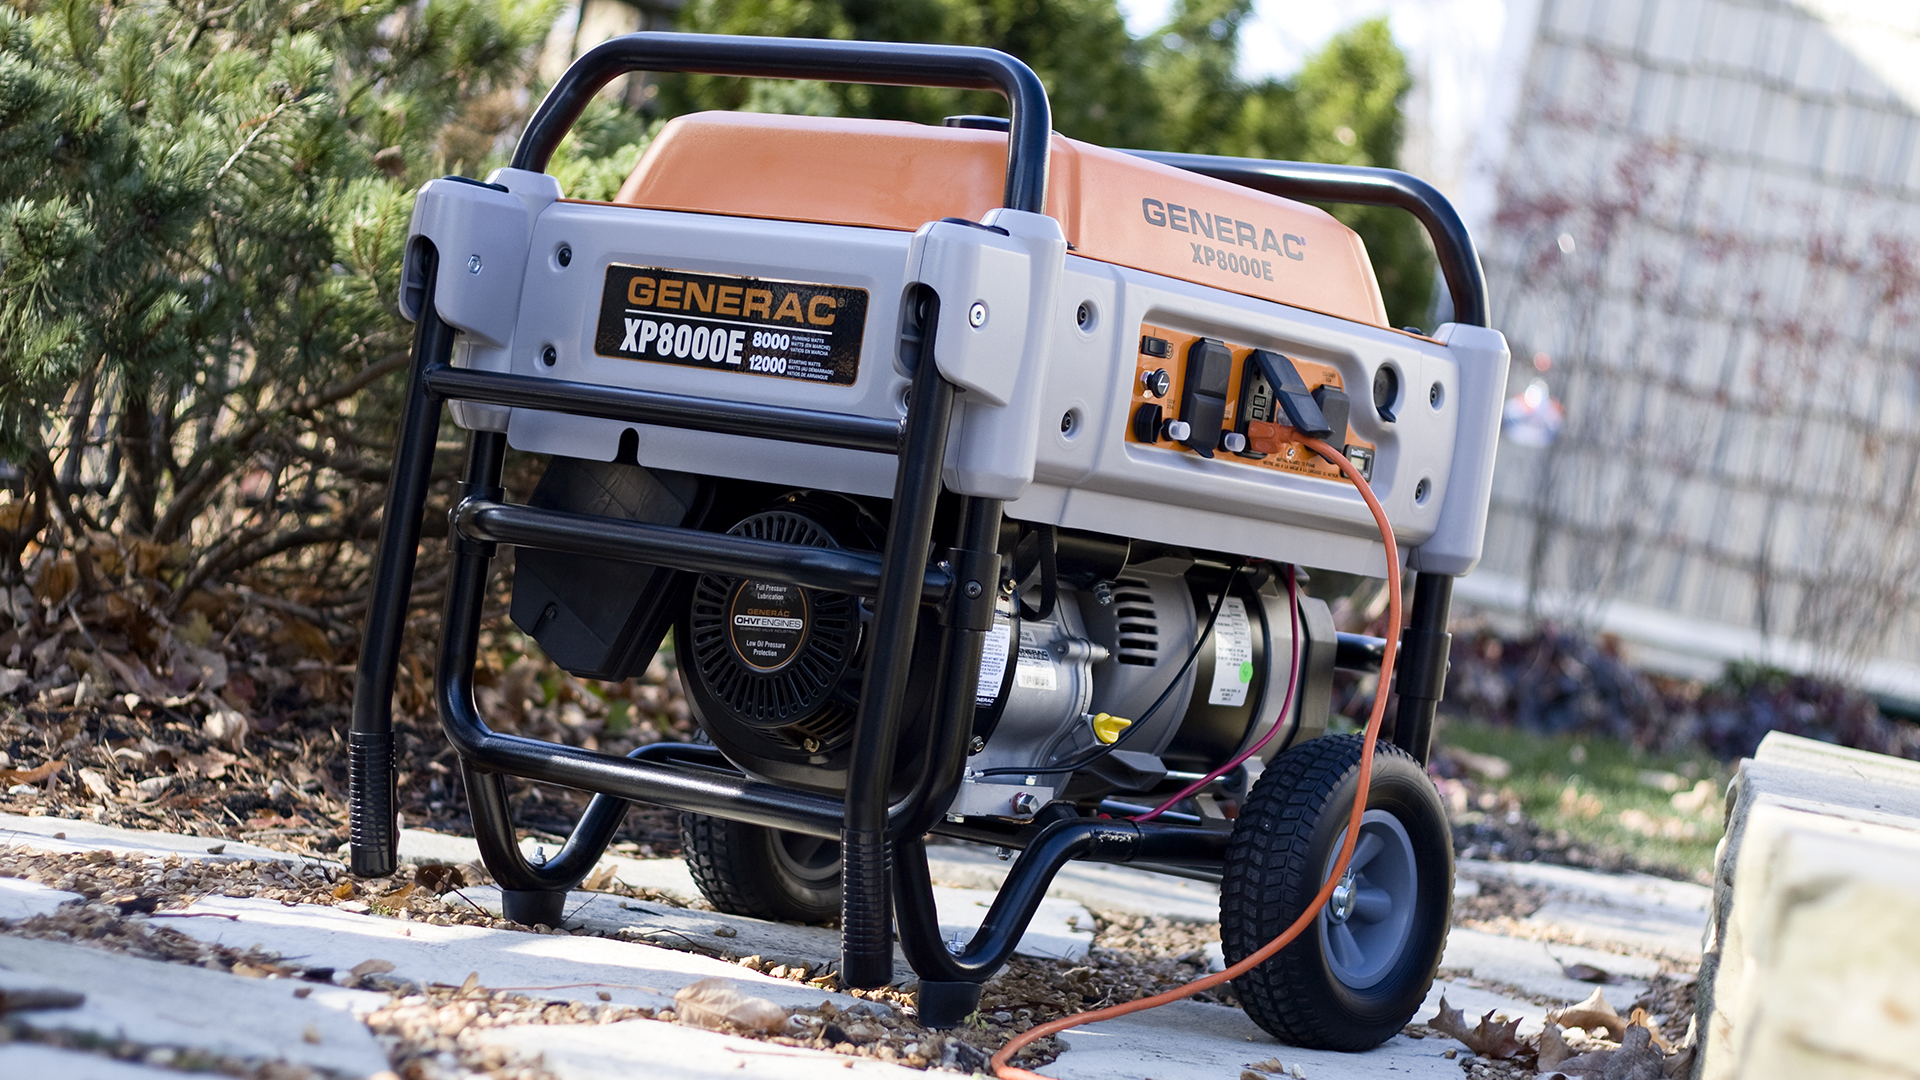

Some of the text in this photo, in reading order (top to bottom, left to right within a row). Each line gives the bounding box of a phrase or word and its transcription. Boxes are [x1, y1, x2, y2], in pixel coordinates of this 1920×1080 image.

[1142, 197, 1304, 261] GENERAC
[1190, 242, 1274, 281] XP8000E
[627, 276, 838, 326] GENERAC
[619, 318, 746, 365] XP8000E
[752, 331, 790, 351] 8000
[749, 354, 787, 374] 12000
[765, 585, 787, 593] Pressure
[757, 593, 784, 601] Lubrication
[747, 608, 790, 617] GENERAC
[761, 618, 802, 628] ENGINES
[764, 640, 786, 649] Pressure
[753, 649, 777, 657] Protection
